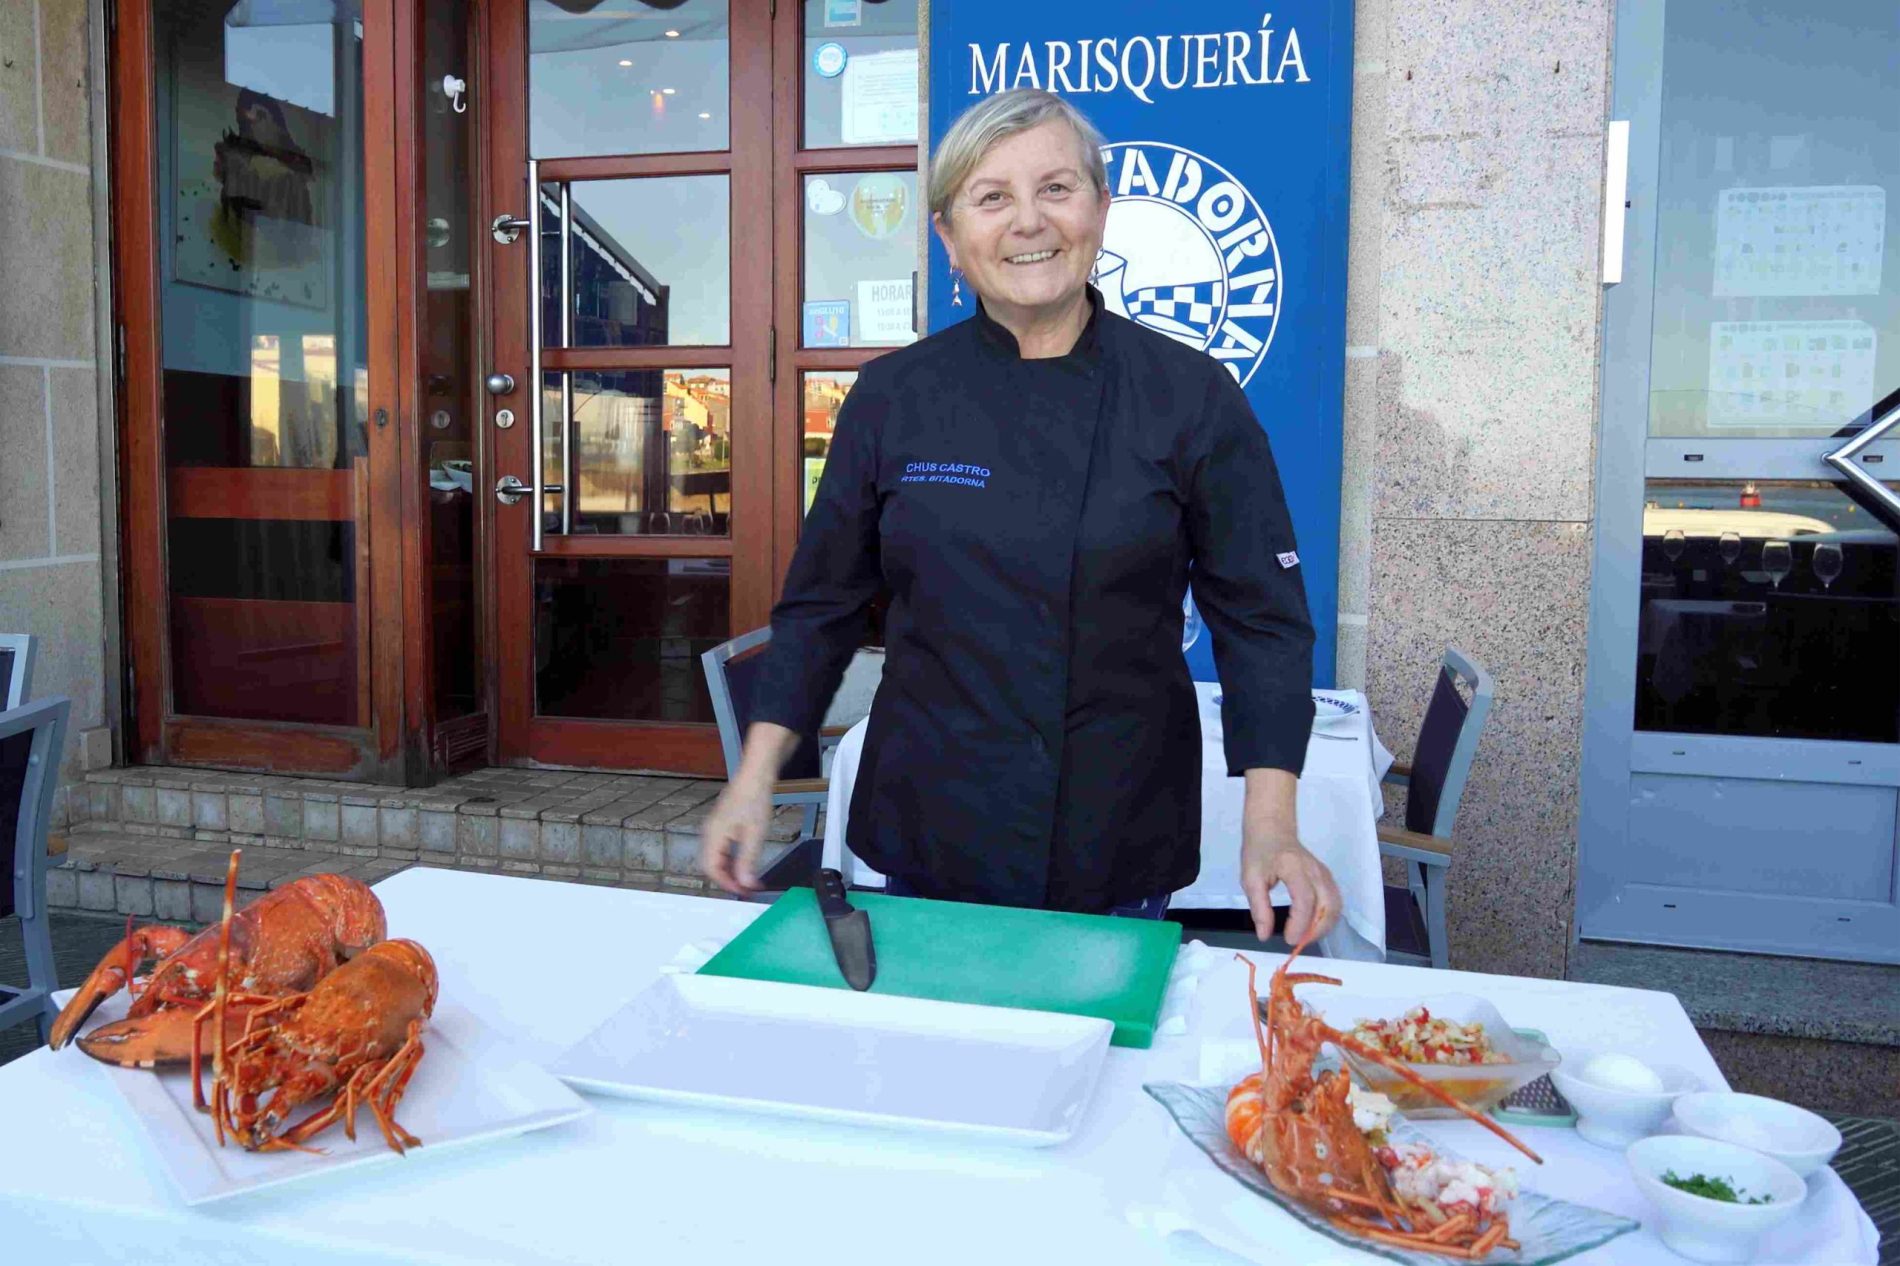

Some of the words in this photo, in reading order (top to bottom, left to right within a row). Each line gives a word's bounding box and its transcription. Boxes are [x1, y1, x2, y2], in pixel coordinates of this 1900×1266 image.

[968, 13, 1311, 104] MARISQUERÍA
[906, 462, 937, 473] CHUS
[939, 463, 991, 477] CASTRO
[928, 475, 985, 488] BITADORNA
